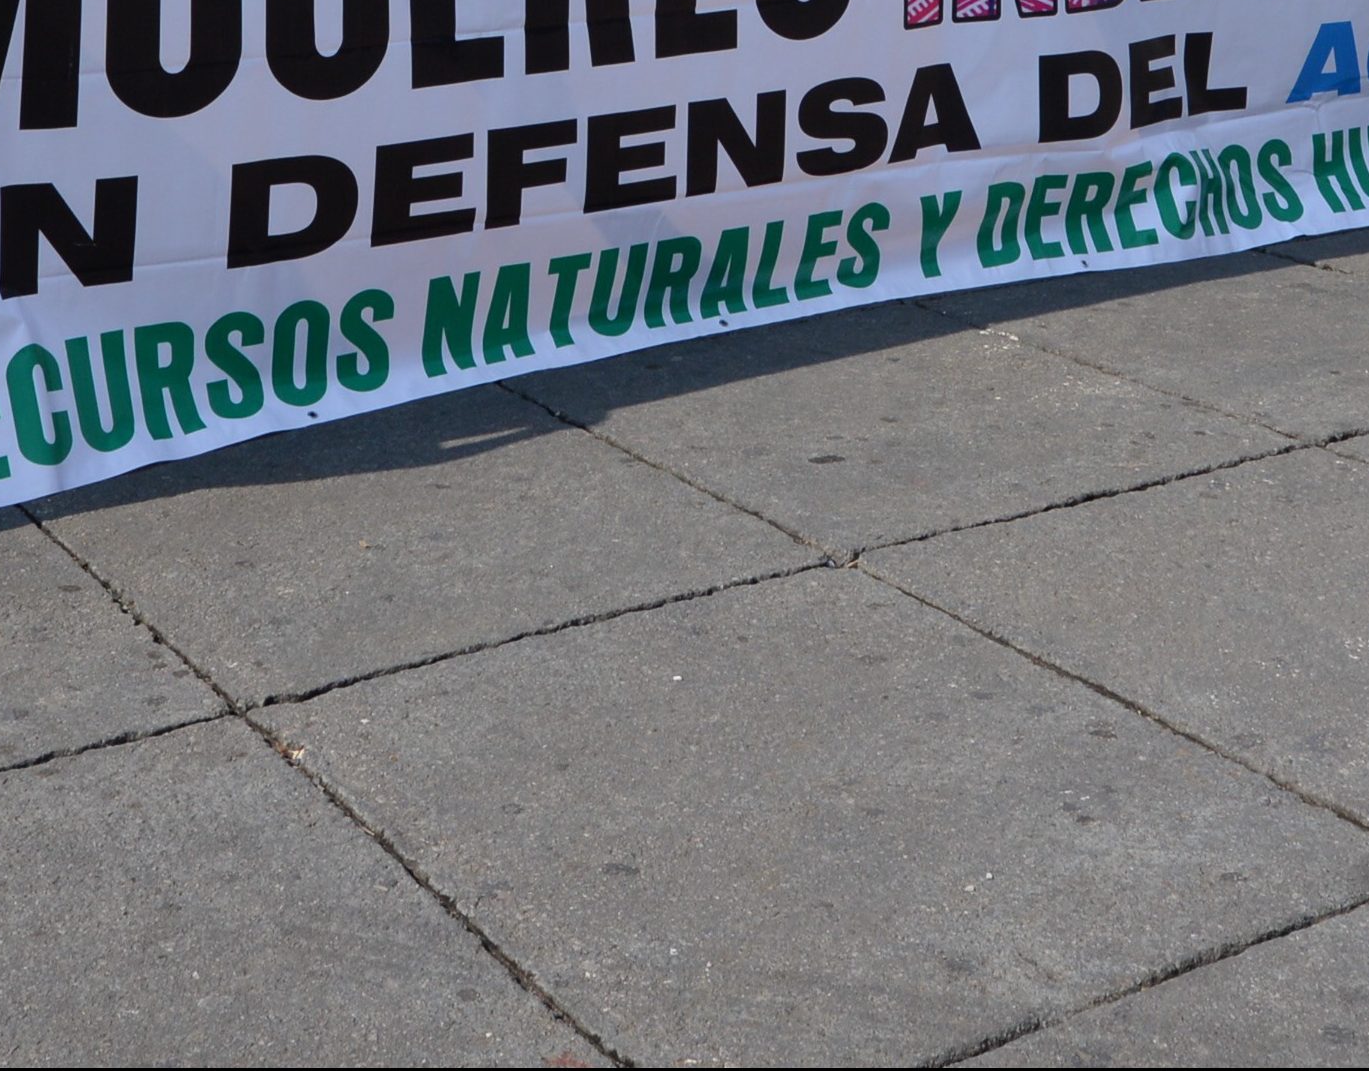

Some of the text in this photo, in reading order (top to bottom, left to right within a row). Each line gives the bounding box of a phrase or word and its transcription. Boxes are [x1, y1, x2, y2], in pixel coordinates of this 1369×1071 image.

[226, 63, 981, 269] DEFENSA
[1038, 31, 1247, 143] DEL
[421, 201, 891, 379] NATURALES
[920, 189, 963, 279] Y
[976, 137, 1305, 269] DERECHOS
